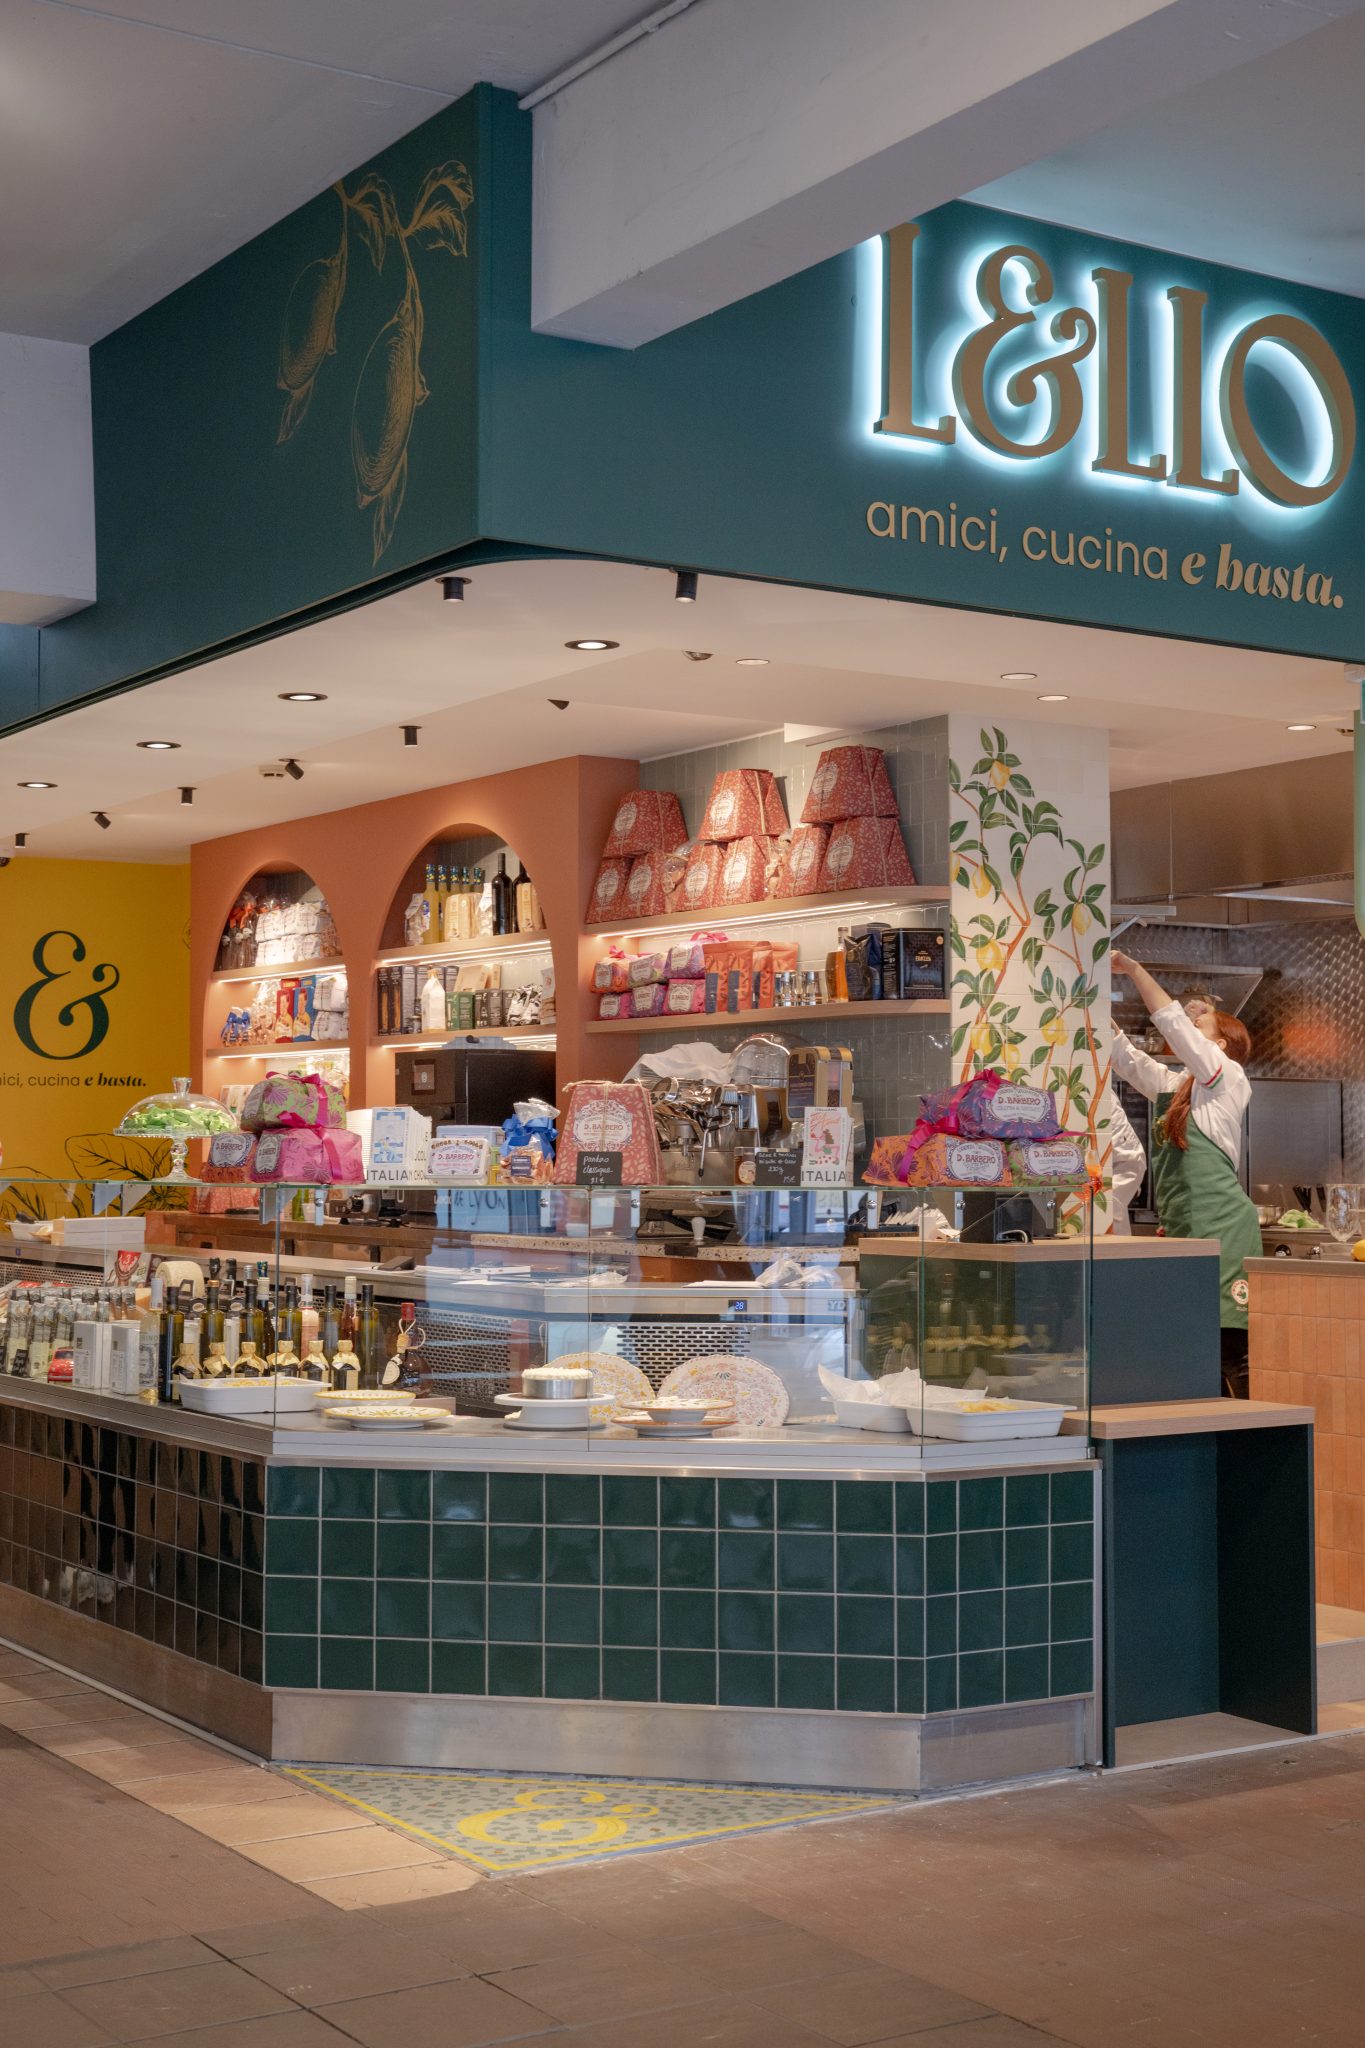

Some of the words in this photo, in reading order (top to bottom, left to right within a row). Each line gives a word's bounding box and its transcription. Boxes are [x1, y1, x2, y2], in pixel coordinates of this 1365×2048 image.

[865, 500, 1008, 564] amici,
[1021, 527, 1169, 581] cucina
[1180, 550, 1206, 586] e
[1216, 543, 1345, 609] basta.
[0, 1072, 24, 1089] ici,
[27, 1072, 81, 1088] cucina
[84, 1076, 95, 1088] e
[97, 1072, 147, 1088] basta.
[1007, 1097, 1041, 1106] BARBERO
[592, 1123, 624, 1131] BABERO
[965, 1154, 996, 1165] BARBERO
[366, 1169, 409, 1181] ITALIA
[801, 1170, 847, 1182] ITALIA
